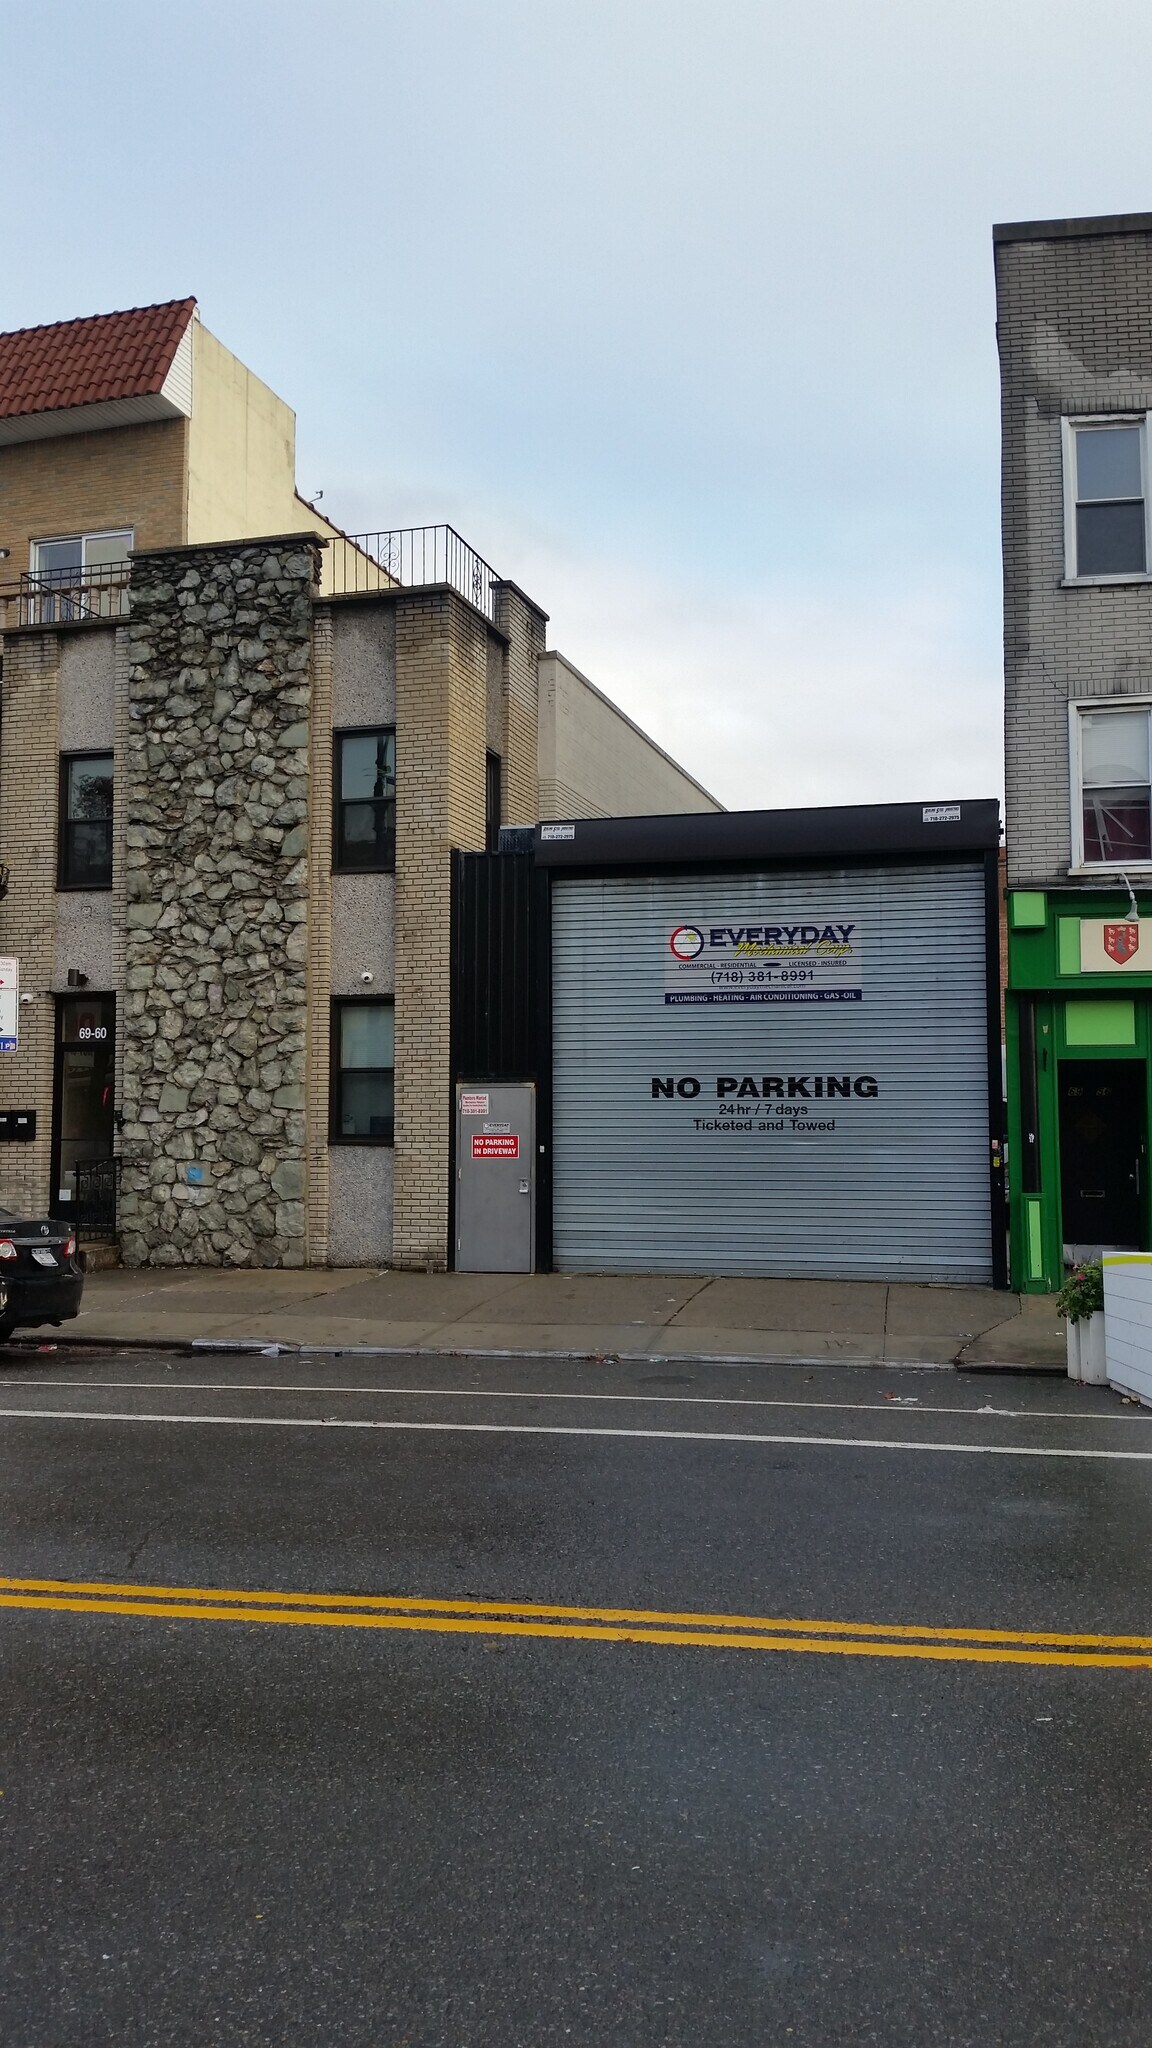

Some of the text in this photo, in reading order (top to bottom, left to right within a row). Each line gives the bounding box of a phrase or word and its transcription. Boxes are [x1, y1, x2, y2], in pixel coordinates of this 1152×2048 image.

[709, 925, 856, 947] EVERYDAY
[733, 940, 853, 958] Mechanical Corp.
[711, 969, 815, 984] (718) 381-8991
[670, 995, 708, 1003] PLUMBING
[763, 993, 819, 1001] CONDITIONING
[79, 1027, 107, 1039] 69-60
[651, 1076, 879, 1099] NO PARKING
[719, 1104, 751, 1115] 24hr
[764, 1104, 772, 1115] 7
[776, 1104, 808, 1117] days
[693, 1119, 836, 1131] Ticketed and Towed
[474, 1147, 517, 1155] IN DRIVEWAY
